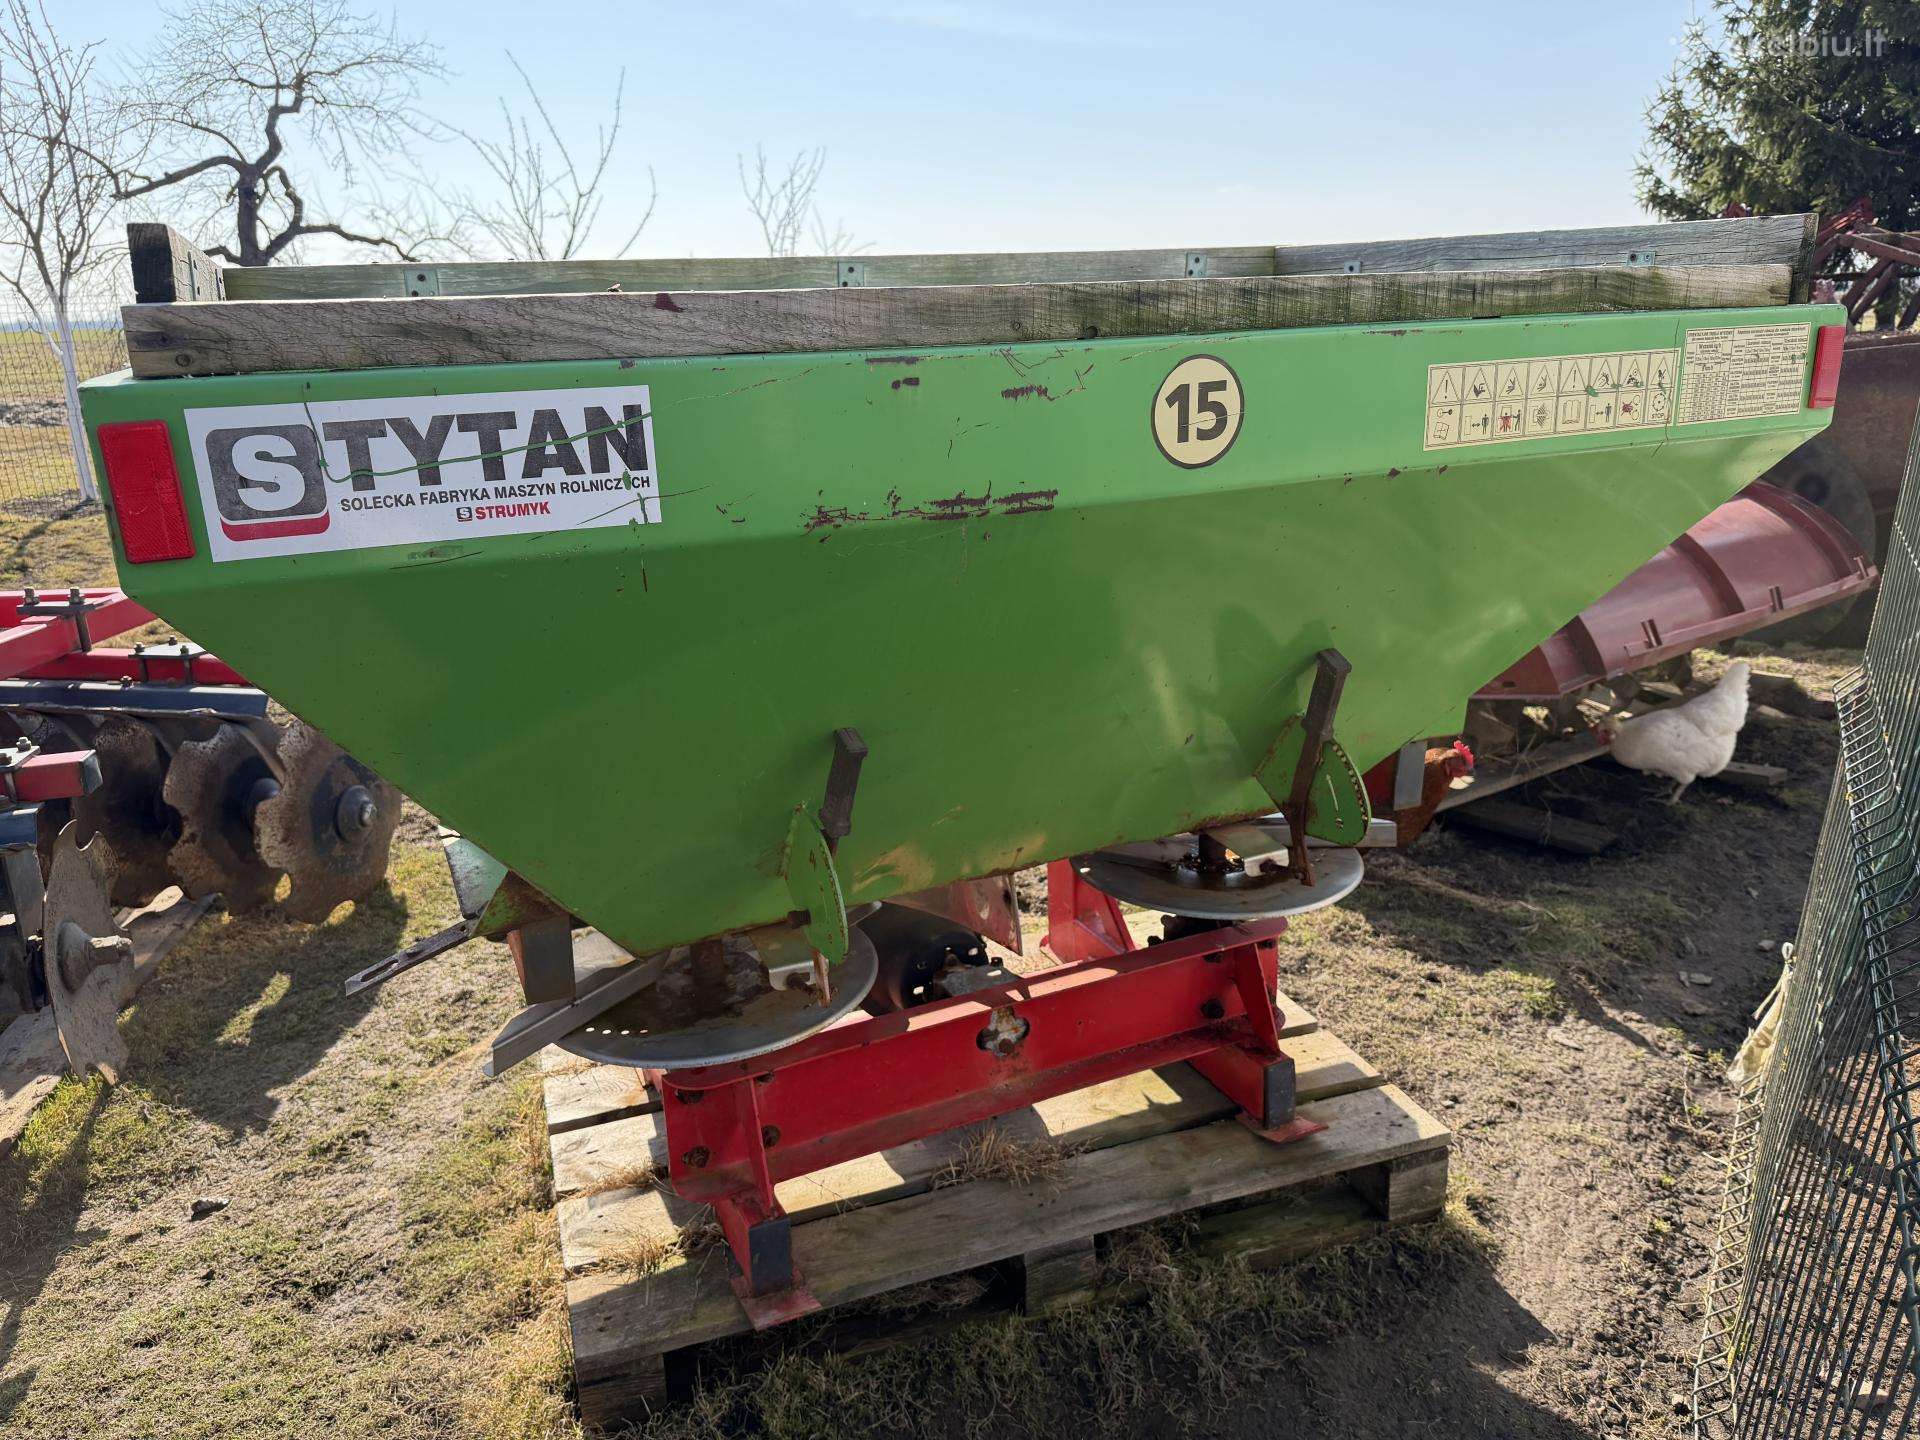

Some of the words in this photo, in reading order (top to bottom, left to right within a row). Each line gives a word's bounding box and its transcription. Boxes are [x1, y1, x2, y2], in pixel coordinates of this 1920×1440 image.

[1165, 379, 1228, 443] 15
[340, 492, 415, 512] SOLECKA
[419, 487, 491, 506] FABRYKA
[494, 481, 556, 499] MASZYN
[560, 475, 650, 494] ROLNICZCH
[475, 501, 551, 520] STRUMYK
